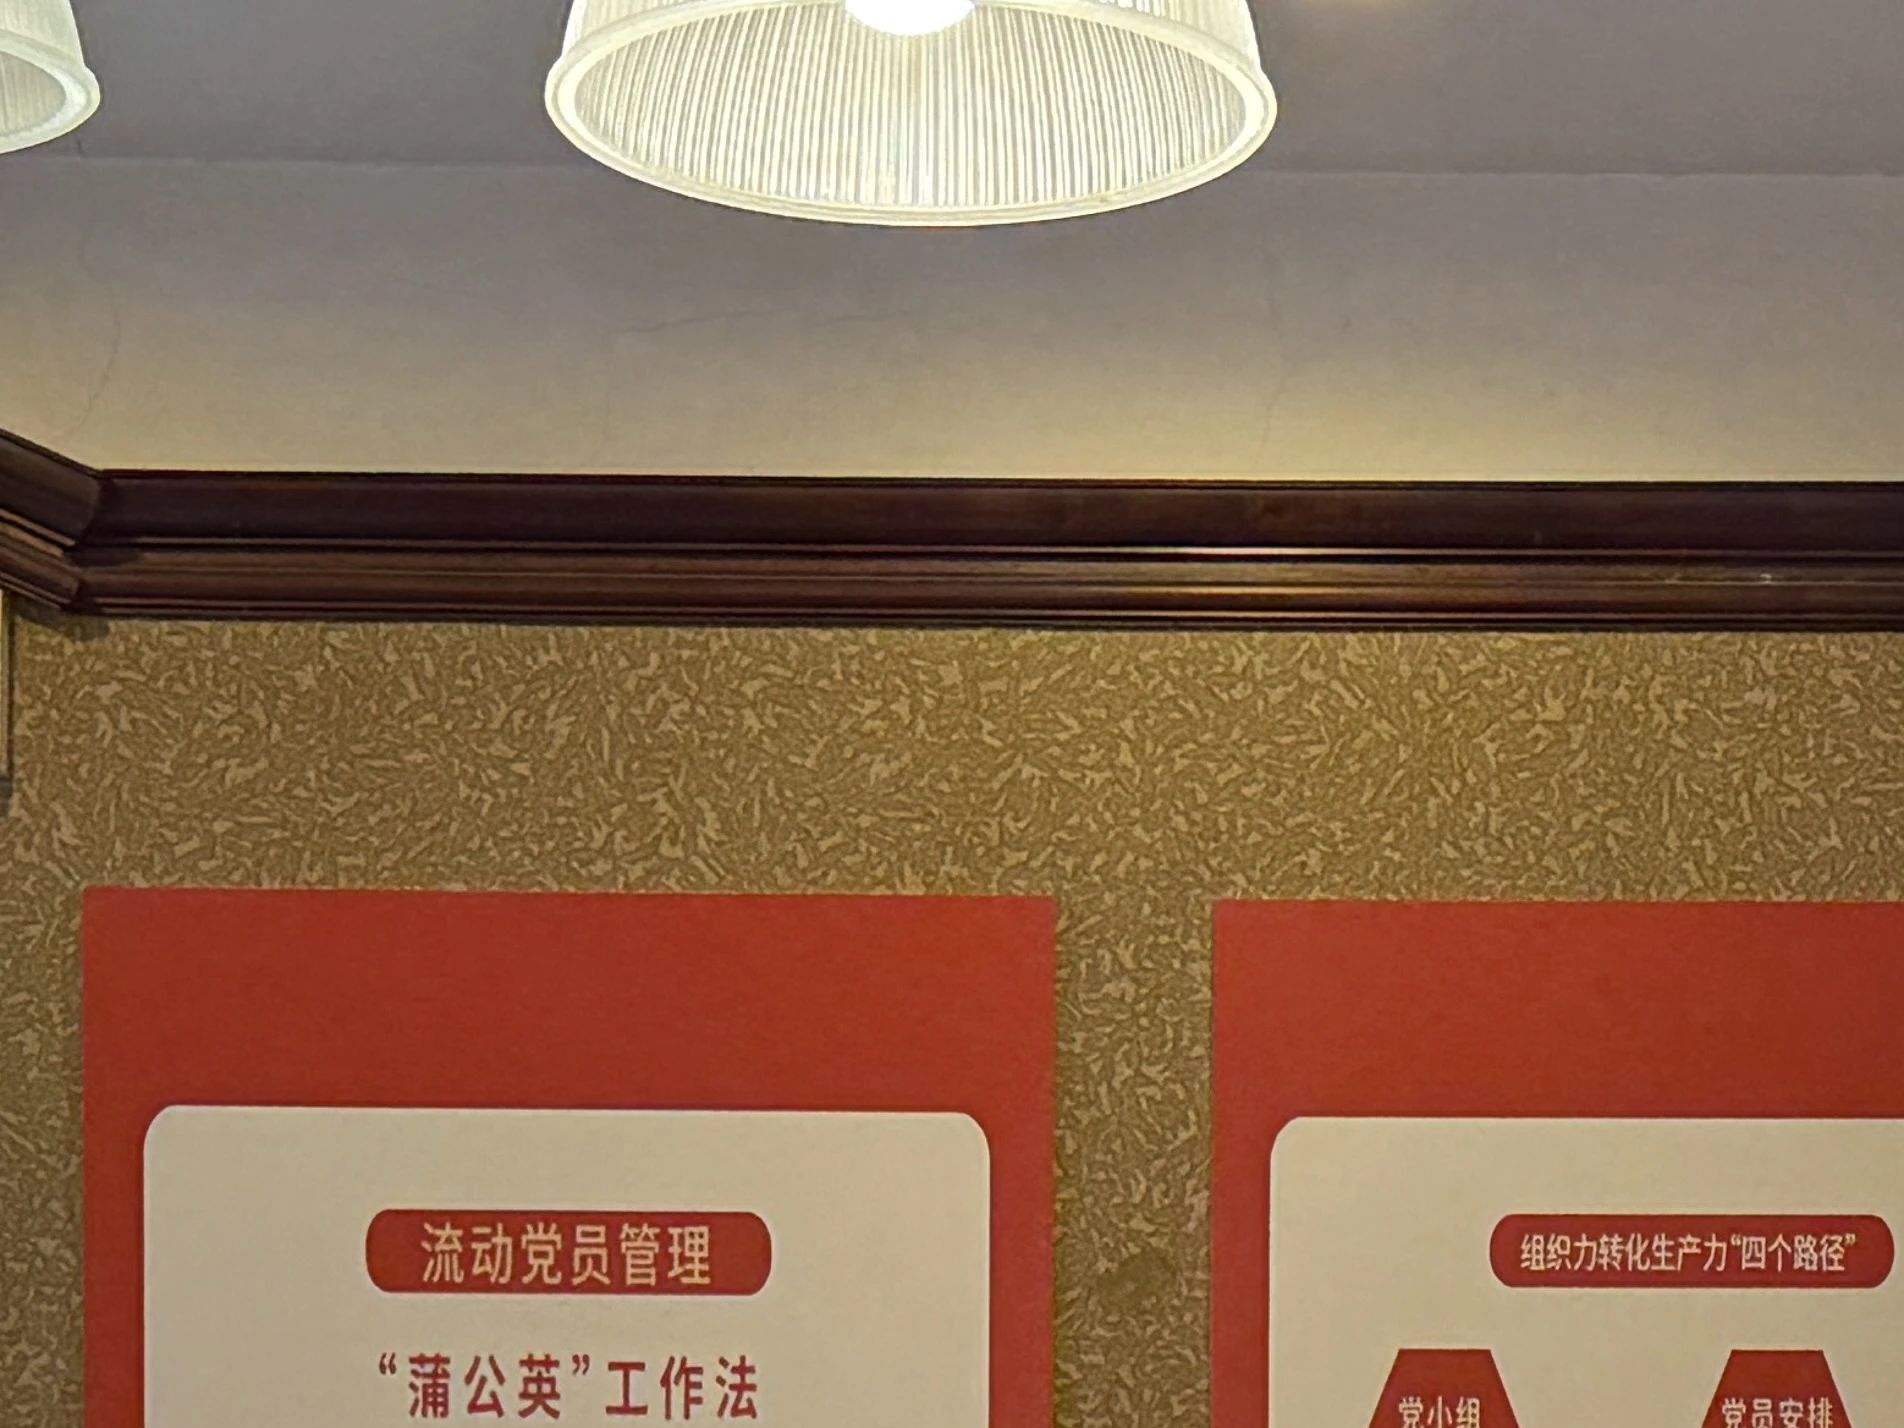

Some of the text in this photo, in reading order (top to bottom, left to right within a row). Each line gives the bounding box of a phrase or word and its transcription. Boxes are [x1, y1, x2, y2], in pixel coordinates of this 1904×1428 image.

[420, 1223, 712, 1286] 流动党员管理
[1520, 1234, 1857, 1274] 组织力转化生产力“四个路径”
[378, 1354, 759, 1420] “蒲公英”工作法
